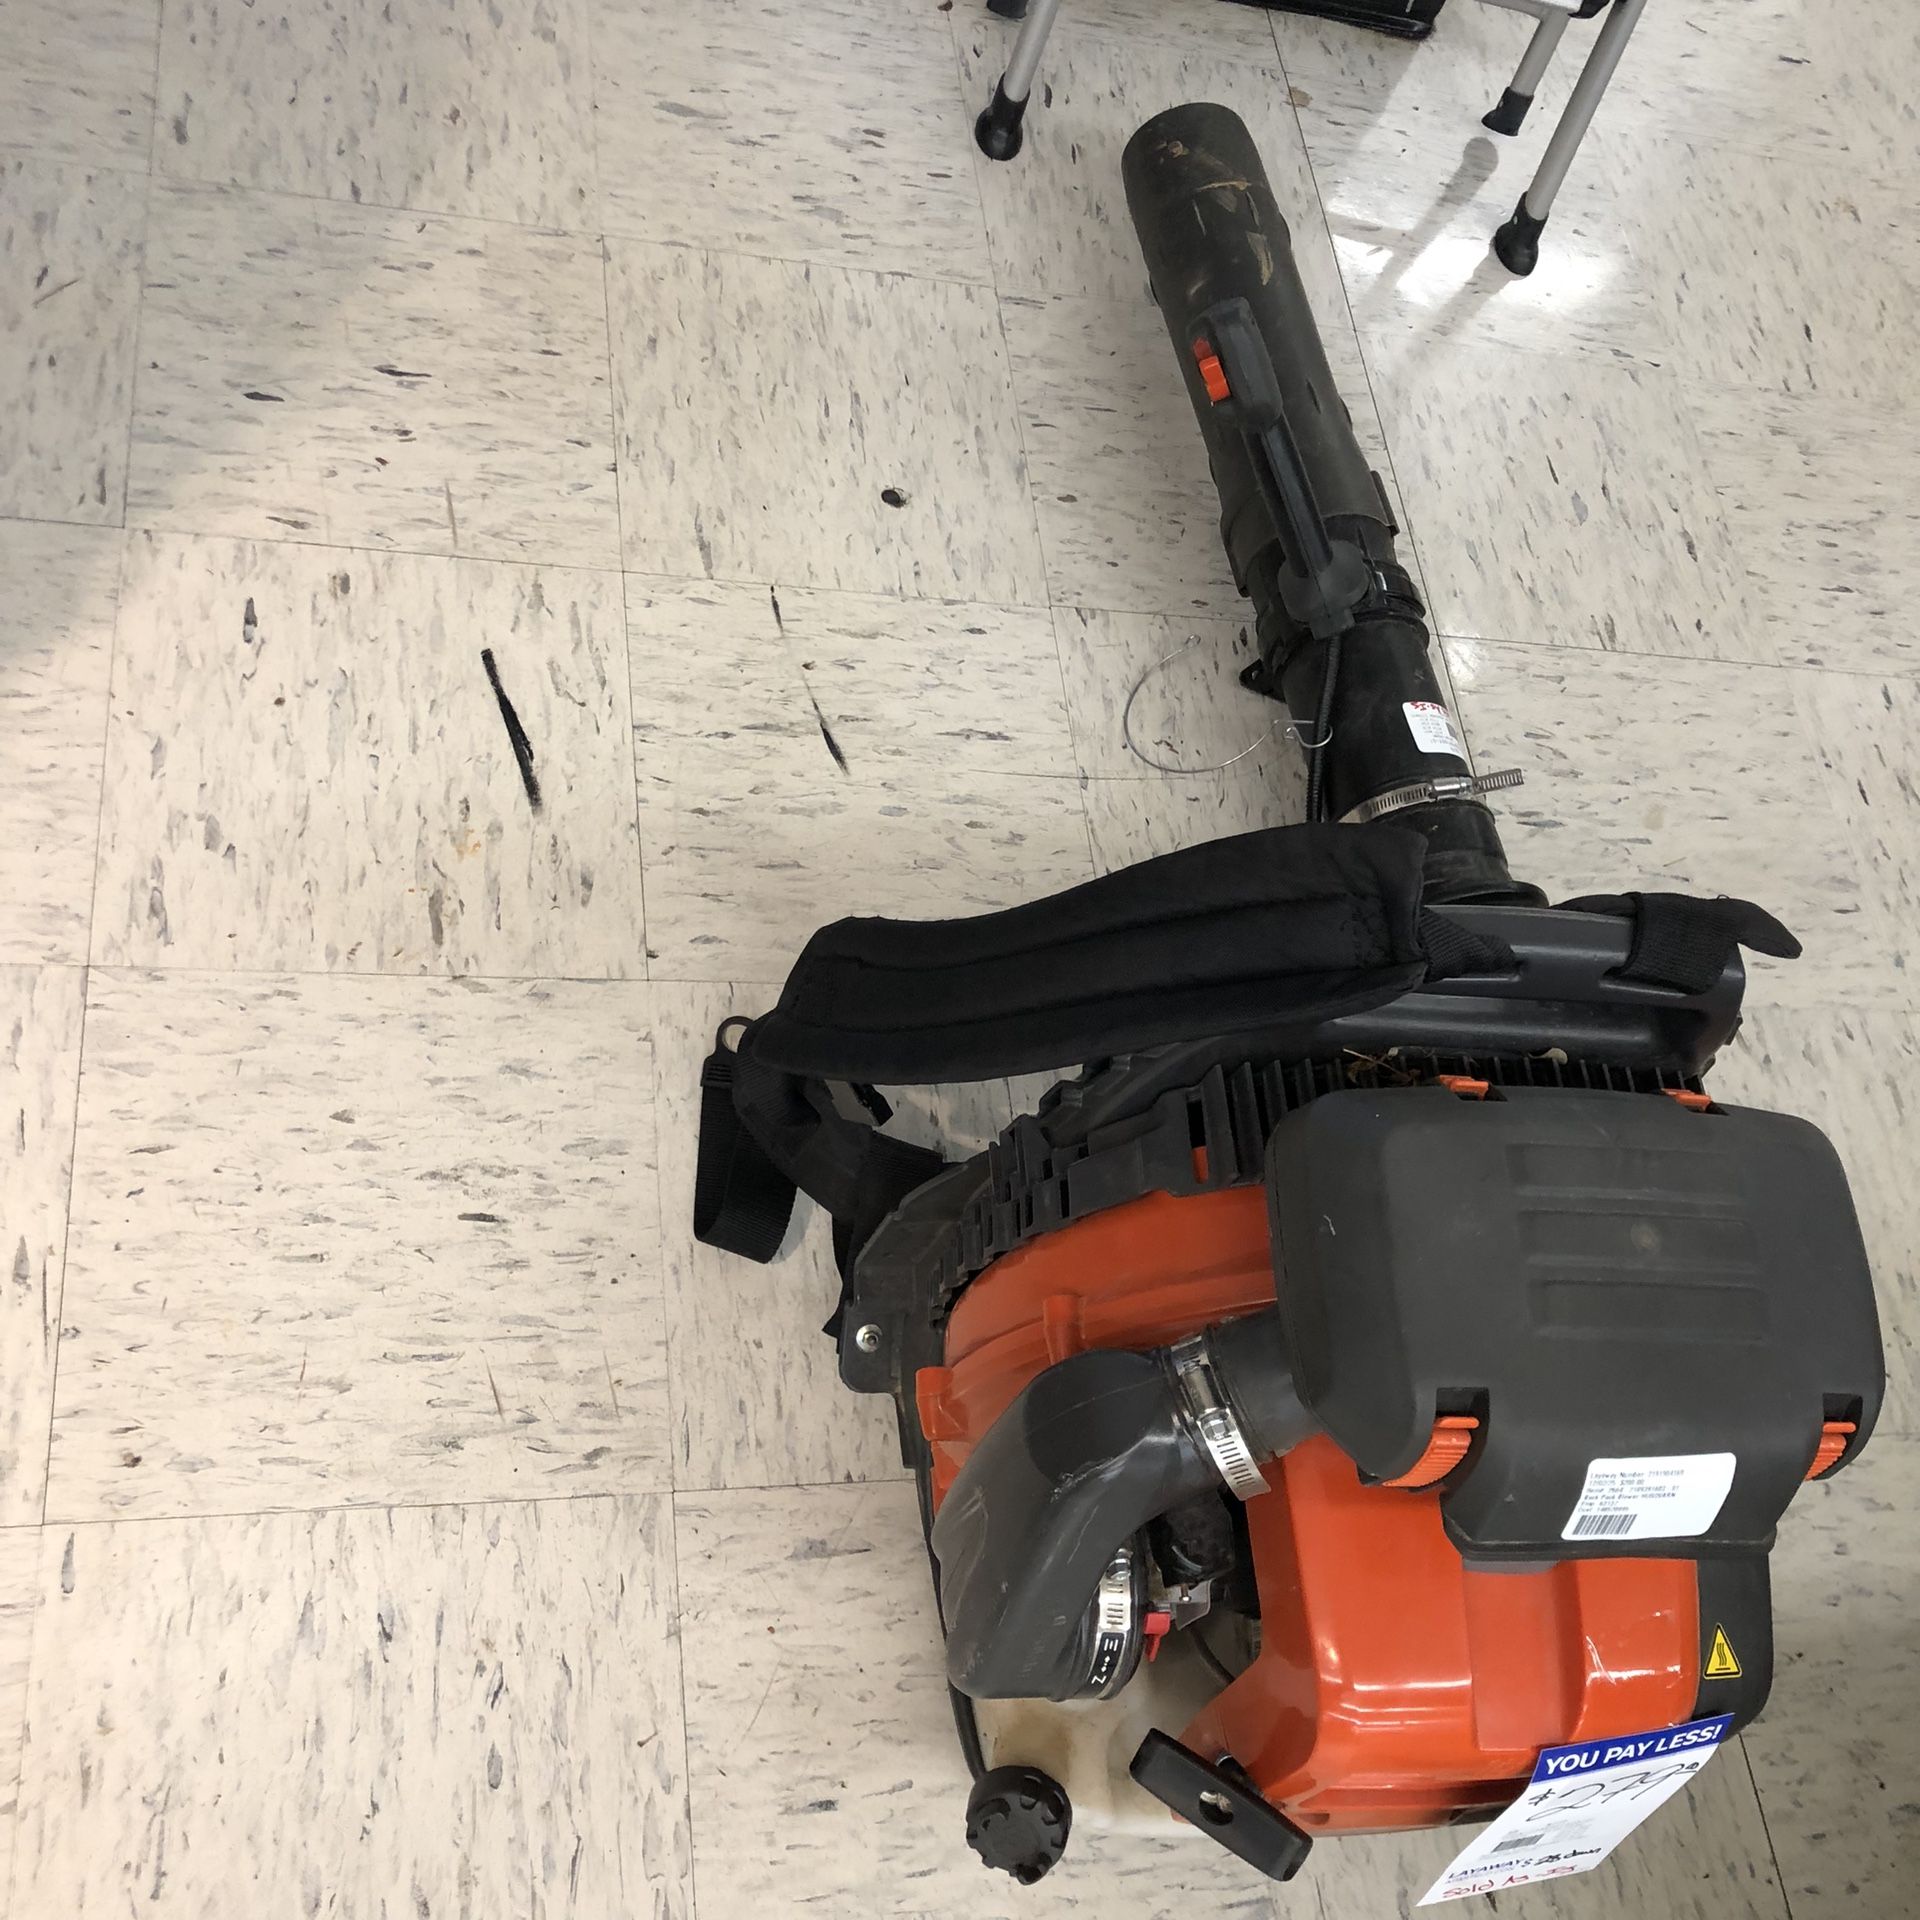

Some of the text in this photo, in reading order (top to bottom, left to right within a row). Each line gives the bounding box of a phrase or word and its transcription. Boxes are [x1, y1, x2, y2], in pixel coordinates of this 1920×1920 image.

[1546, 1724, 1723, 1775] YOU PAY LESS!
